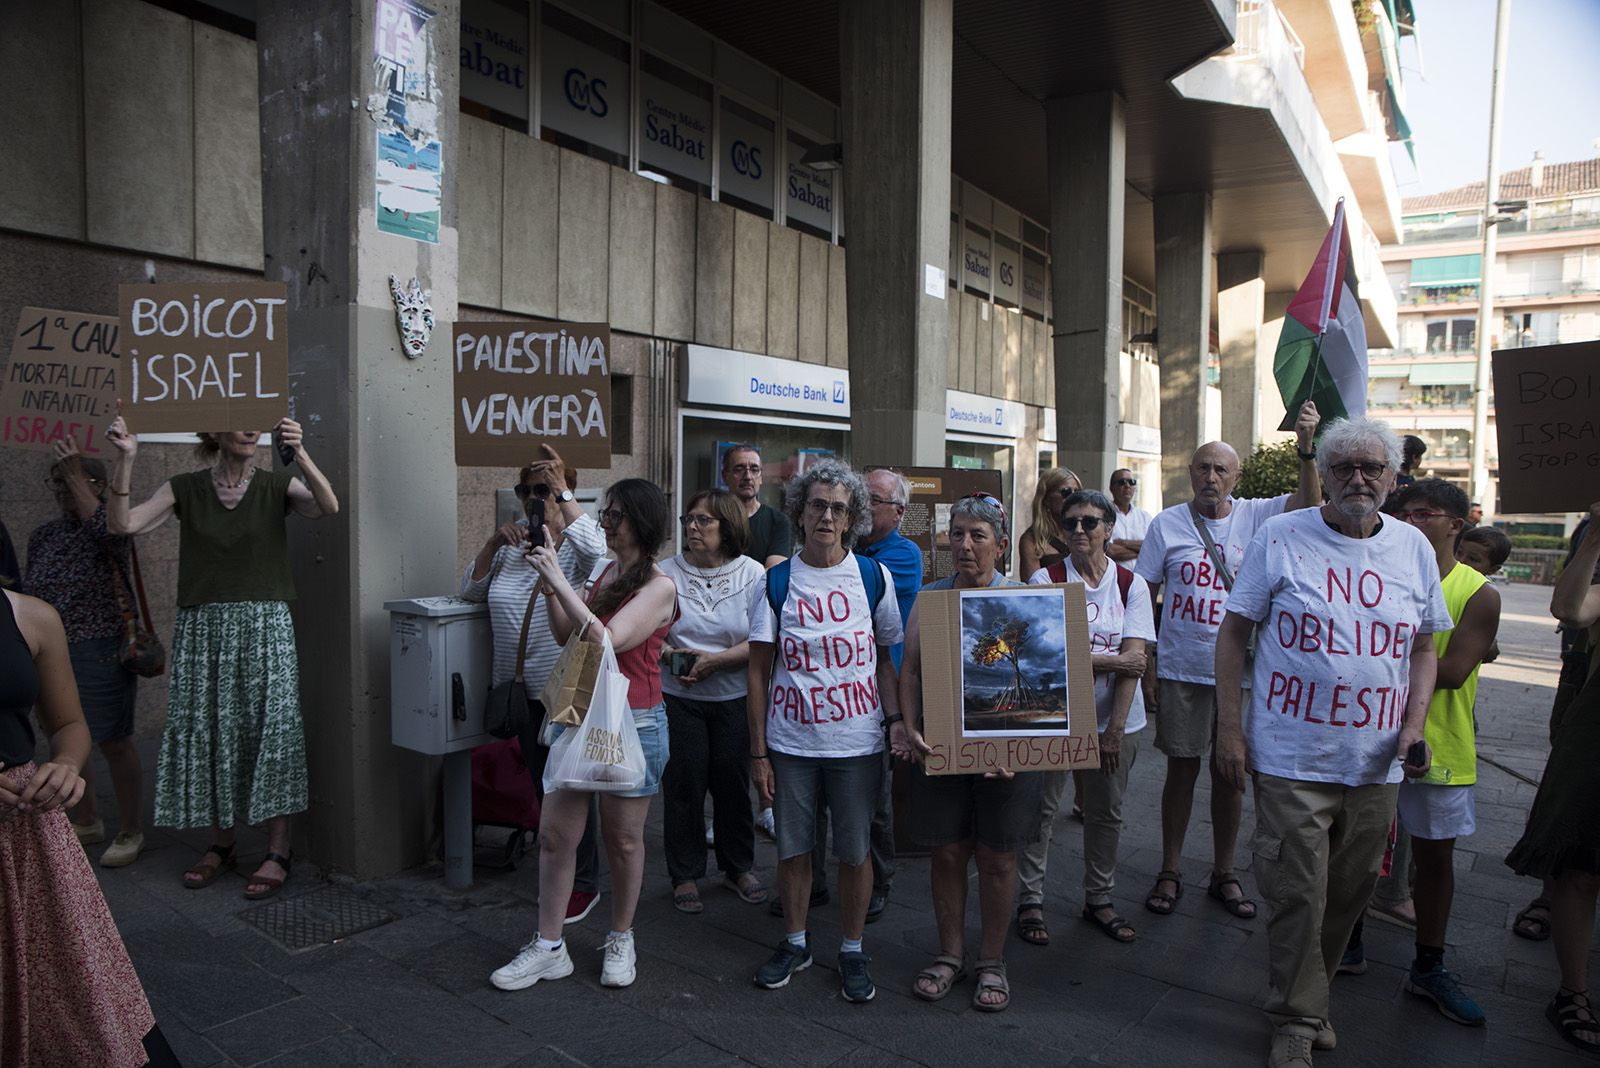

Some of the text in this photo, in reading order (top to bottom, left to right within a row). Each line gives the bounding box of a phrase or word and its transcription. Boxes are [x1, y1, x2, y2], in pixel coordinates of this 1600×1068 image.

[646, 114, 705, 160] Sabat
[789, 172, 832, 212] Sabat
[71, 321, 120, 358] CAU
[750, 378, 827, 402] Deutsche Bank
[1518, 371, 1600, 405] BOI
[461, 388, 607, 438] VENCERÀ
[950, 407, 992, 423] Deutsche Bank
[3, 415, 101, 453] ISRAEL
[1513, 420, 1600, 446] ISRA
[1518, 451, 1579, 471] STOP
[1327, 567, 1384, 609] NO
[798, 591, 850, 627] NO
